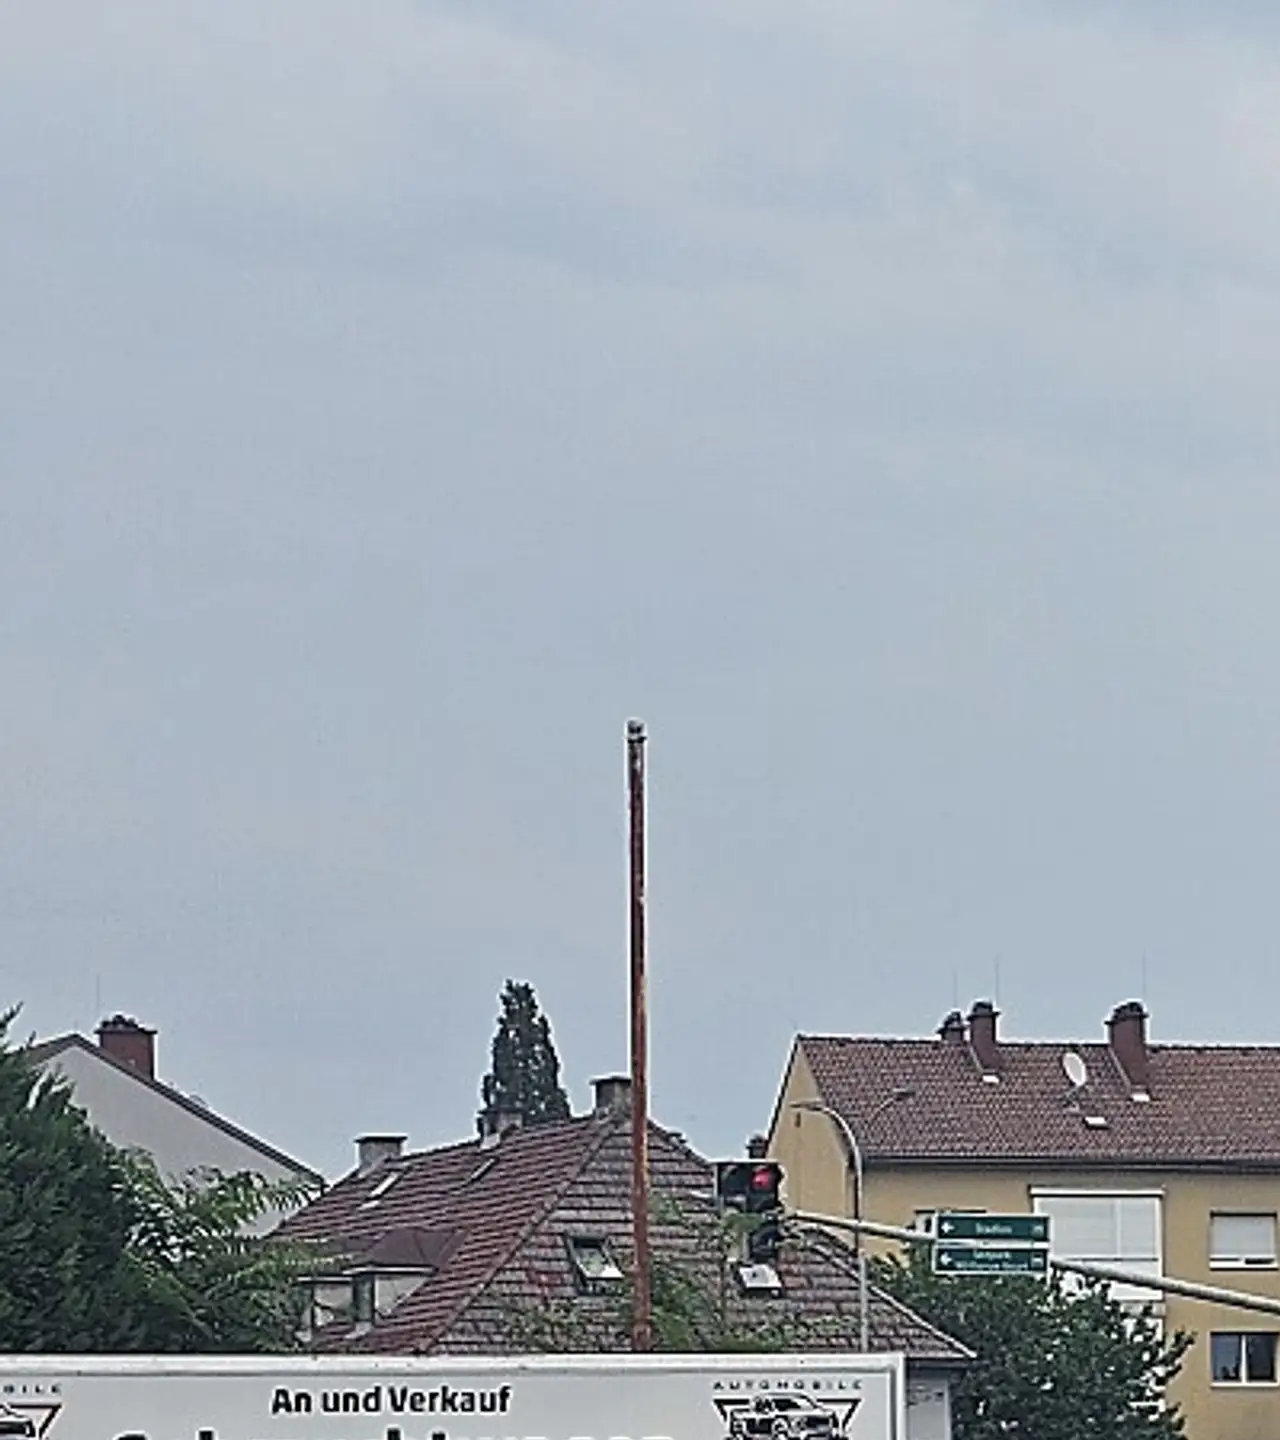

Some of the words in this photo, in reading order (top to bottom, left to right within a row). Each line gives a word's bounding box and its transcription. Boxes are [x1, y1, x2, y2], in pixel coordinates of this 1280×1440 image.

[272, 1388, 312, 1414] An
[321, 1386, 382, 1413] und
[388, 1385, 512, 1413] Verkauf
